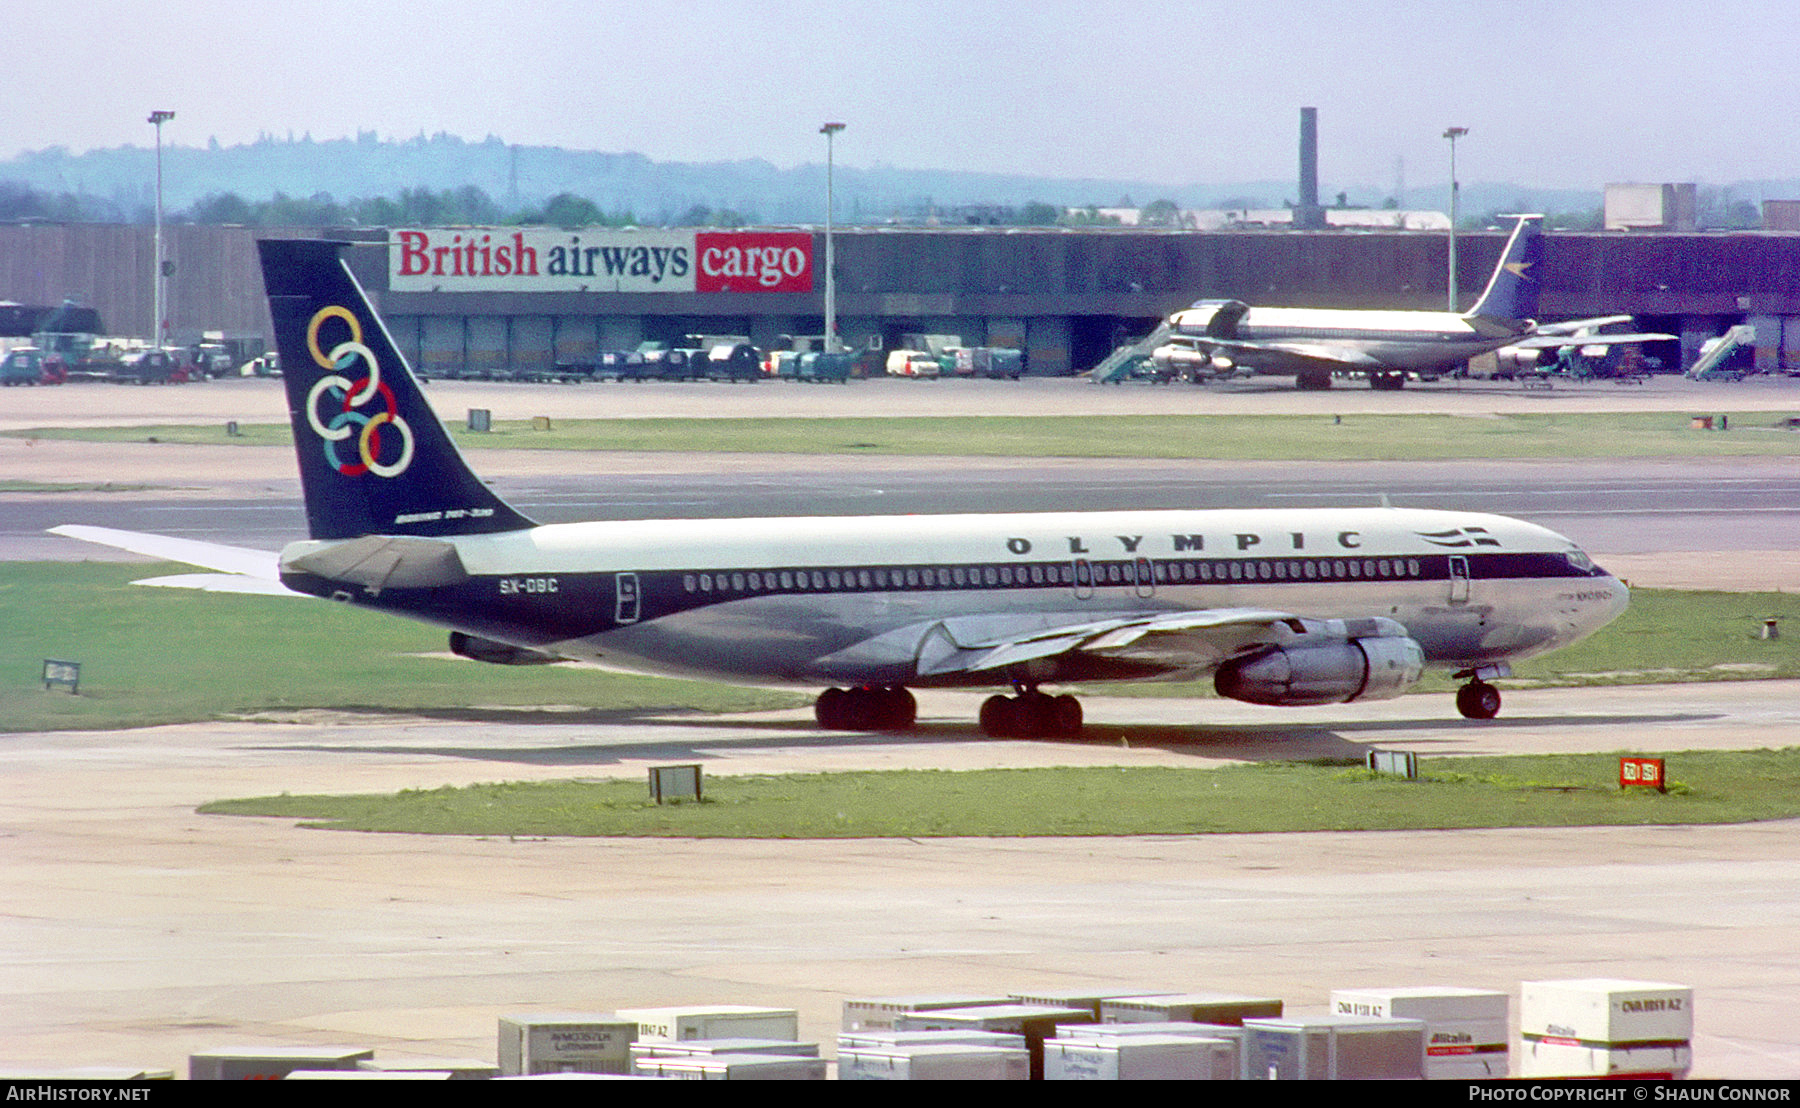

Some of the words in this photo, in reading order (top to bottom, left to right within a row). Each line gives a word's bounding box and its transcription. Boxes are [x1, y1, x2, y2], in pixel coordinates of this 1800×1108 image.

[397, 231, 540, 276] British
[548, 236, 689, 284] airways
[702, 246, 806, 287] cargo
[1006, 531, 1362, 555] OLYMPIC
[1431, 1031, 1473, 1044] Alitalia
